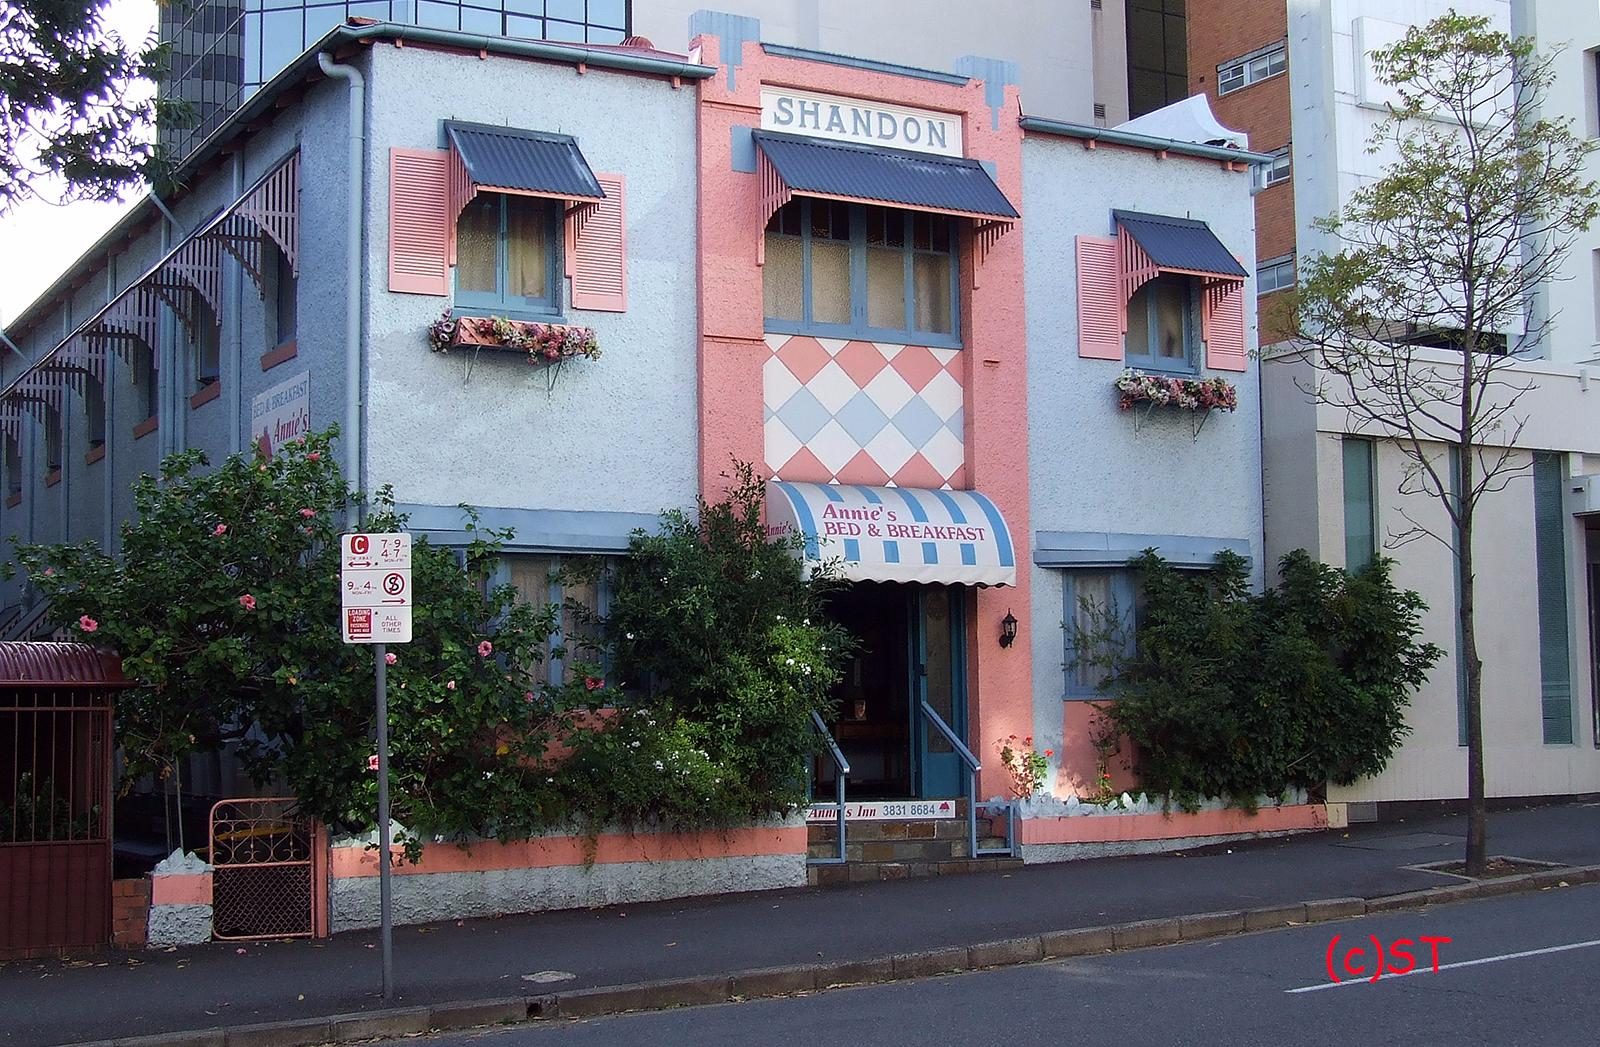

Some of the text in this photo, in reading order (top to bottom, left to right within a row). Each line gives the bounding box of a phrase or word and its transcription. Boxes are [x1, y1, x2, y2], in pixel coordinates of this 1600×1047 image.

[774, 97, 947, 148] SHANDON
[271, 381, 308, 410] BREAKFAST
[273, 408, 308, 444] Annie's
[823, 503, 897, 522] Annie's
[825, 522, 985, 541] BED & BREAKFAST
[353, 615, 366, 623] ZONE
[857, 805, 877, 818] Inn
[883, 804, 907, 817] 3831
[910, 803, 936, 816] 8684
